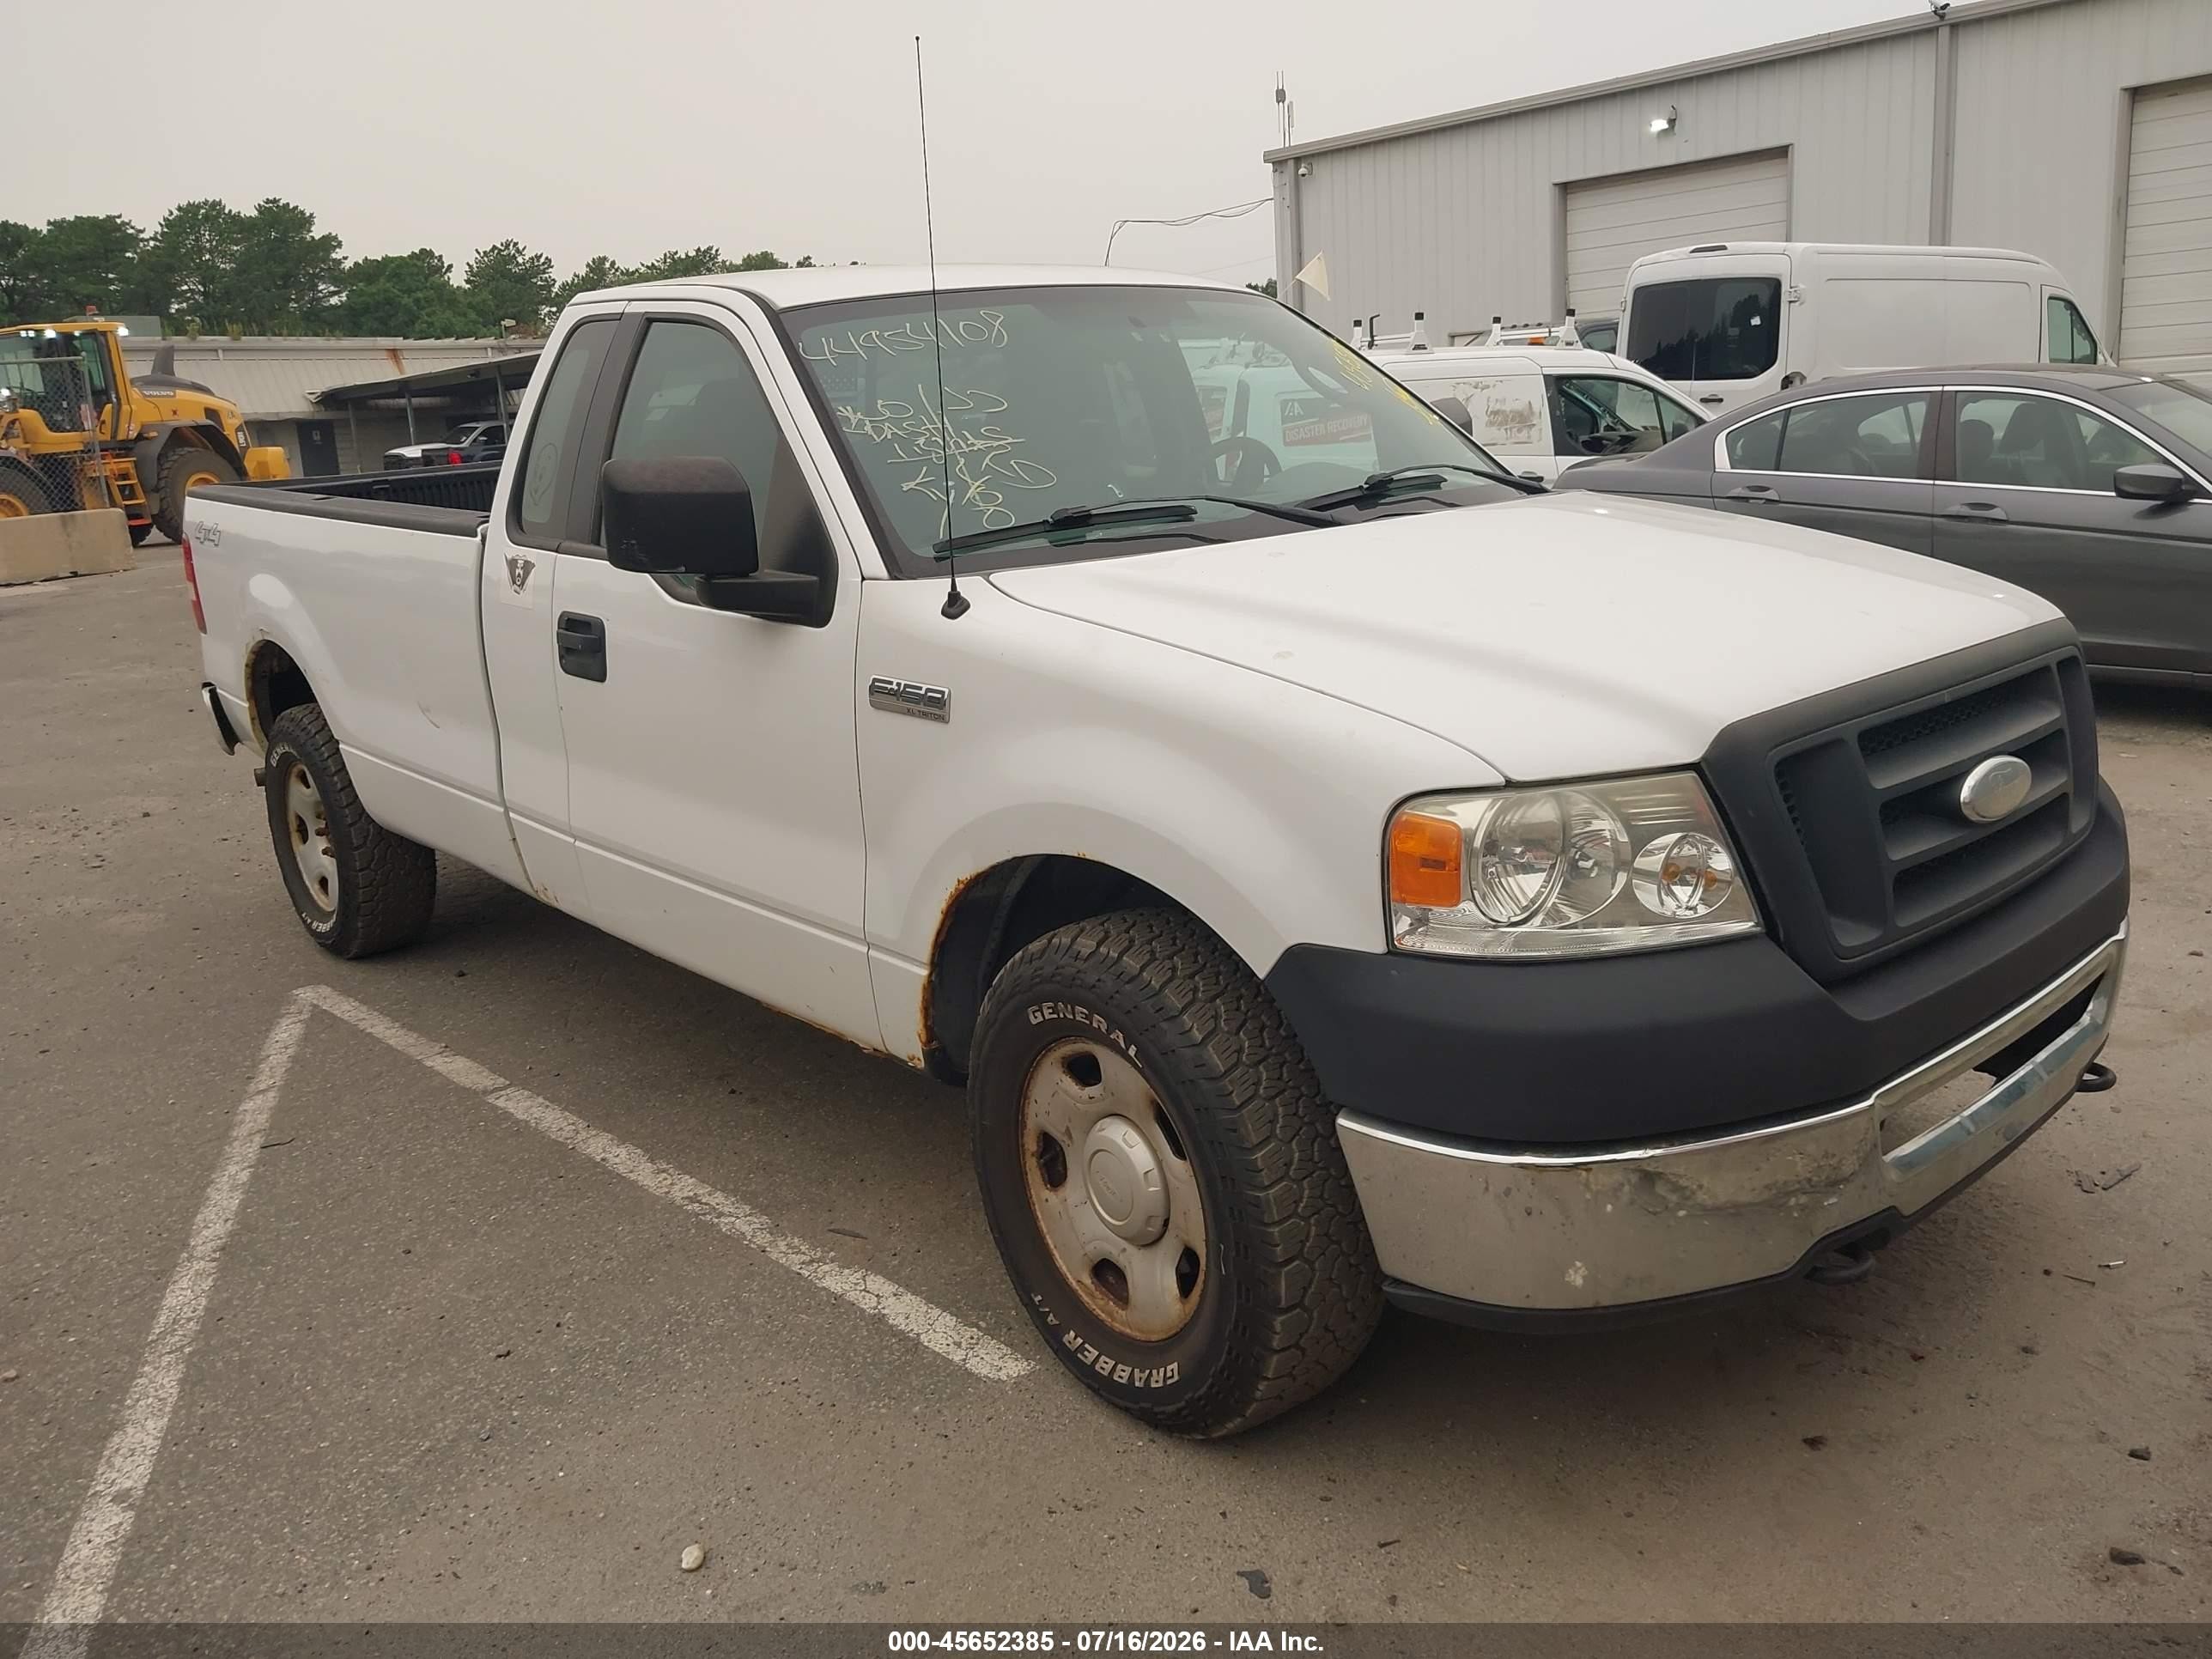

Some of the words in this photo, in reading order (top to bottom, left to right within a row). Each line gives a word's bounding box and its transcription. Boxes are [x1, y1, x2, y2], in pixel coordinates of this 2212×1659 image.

[1285, 423, 1326, 442] DISASTER
[1028, 1002, 1143, 1068] GENERAL
[1030, 1293, 1061, 1327] A/T
[1062, 1329, 1181, 1389] GRABBER
